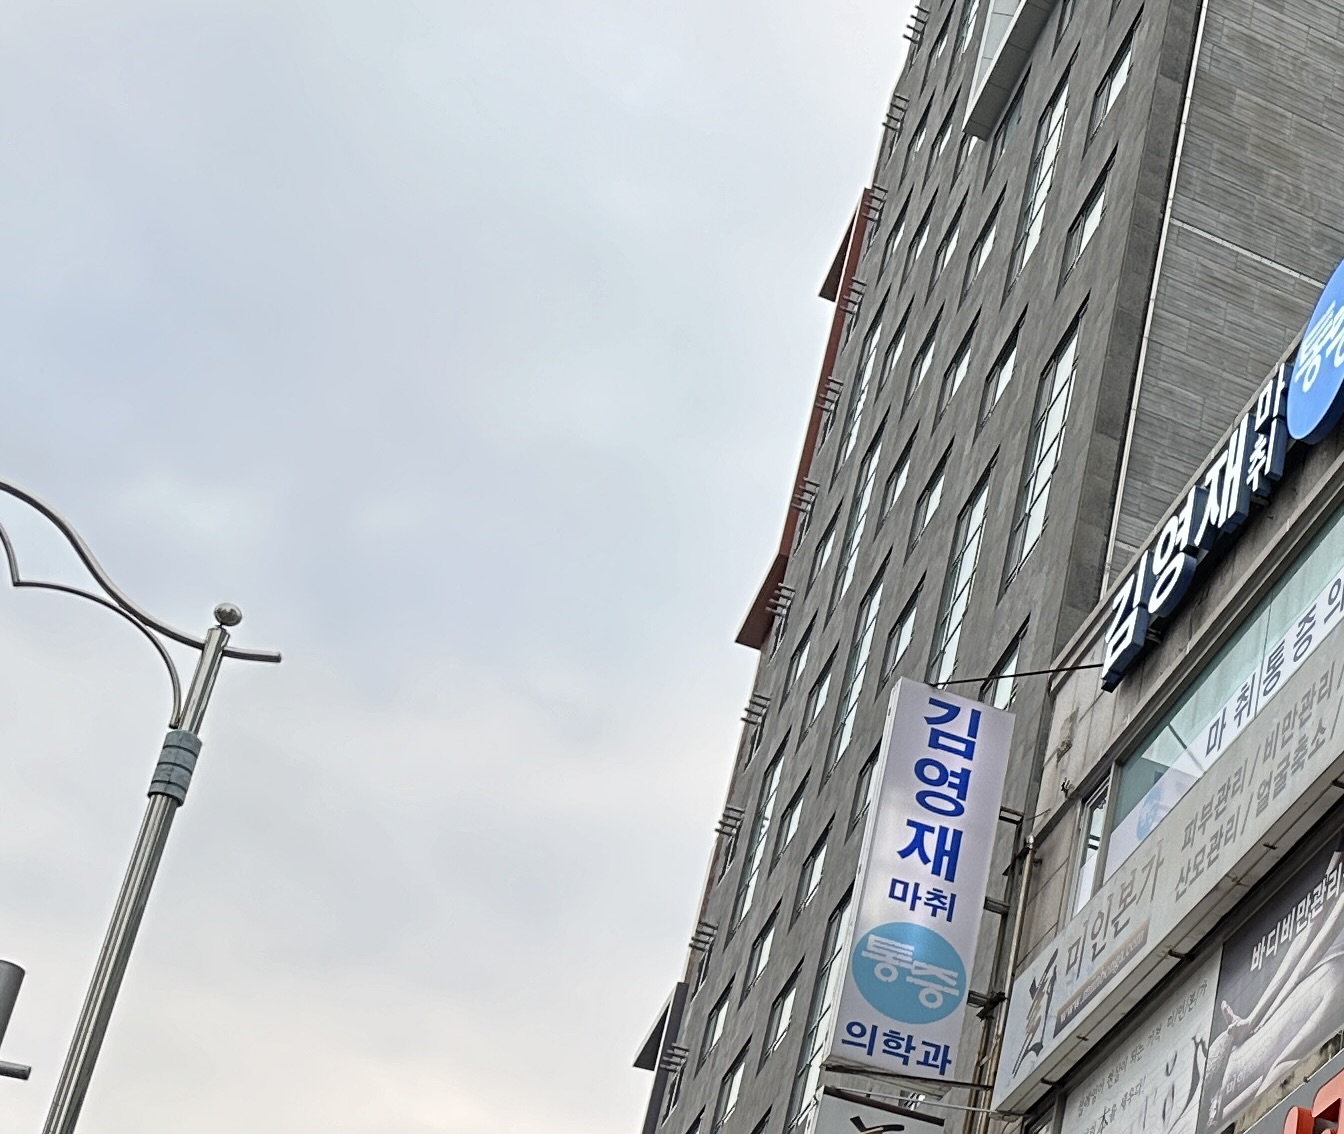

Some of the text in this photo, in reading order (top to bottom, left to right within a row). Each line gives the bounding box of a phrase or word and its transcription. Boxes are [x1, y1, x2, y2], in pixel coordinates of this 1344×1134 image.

[1101, 412, 1250, 680] 김영재
[897, 697, 982, 884] 김영재
[888, 877, 958, 923] 마취
[1065, 840, 1165, 980] 미인본가
[861, 932, 960, 1011] 통증
[840, 1019, 953, 1076] 의학과
